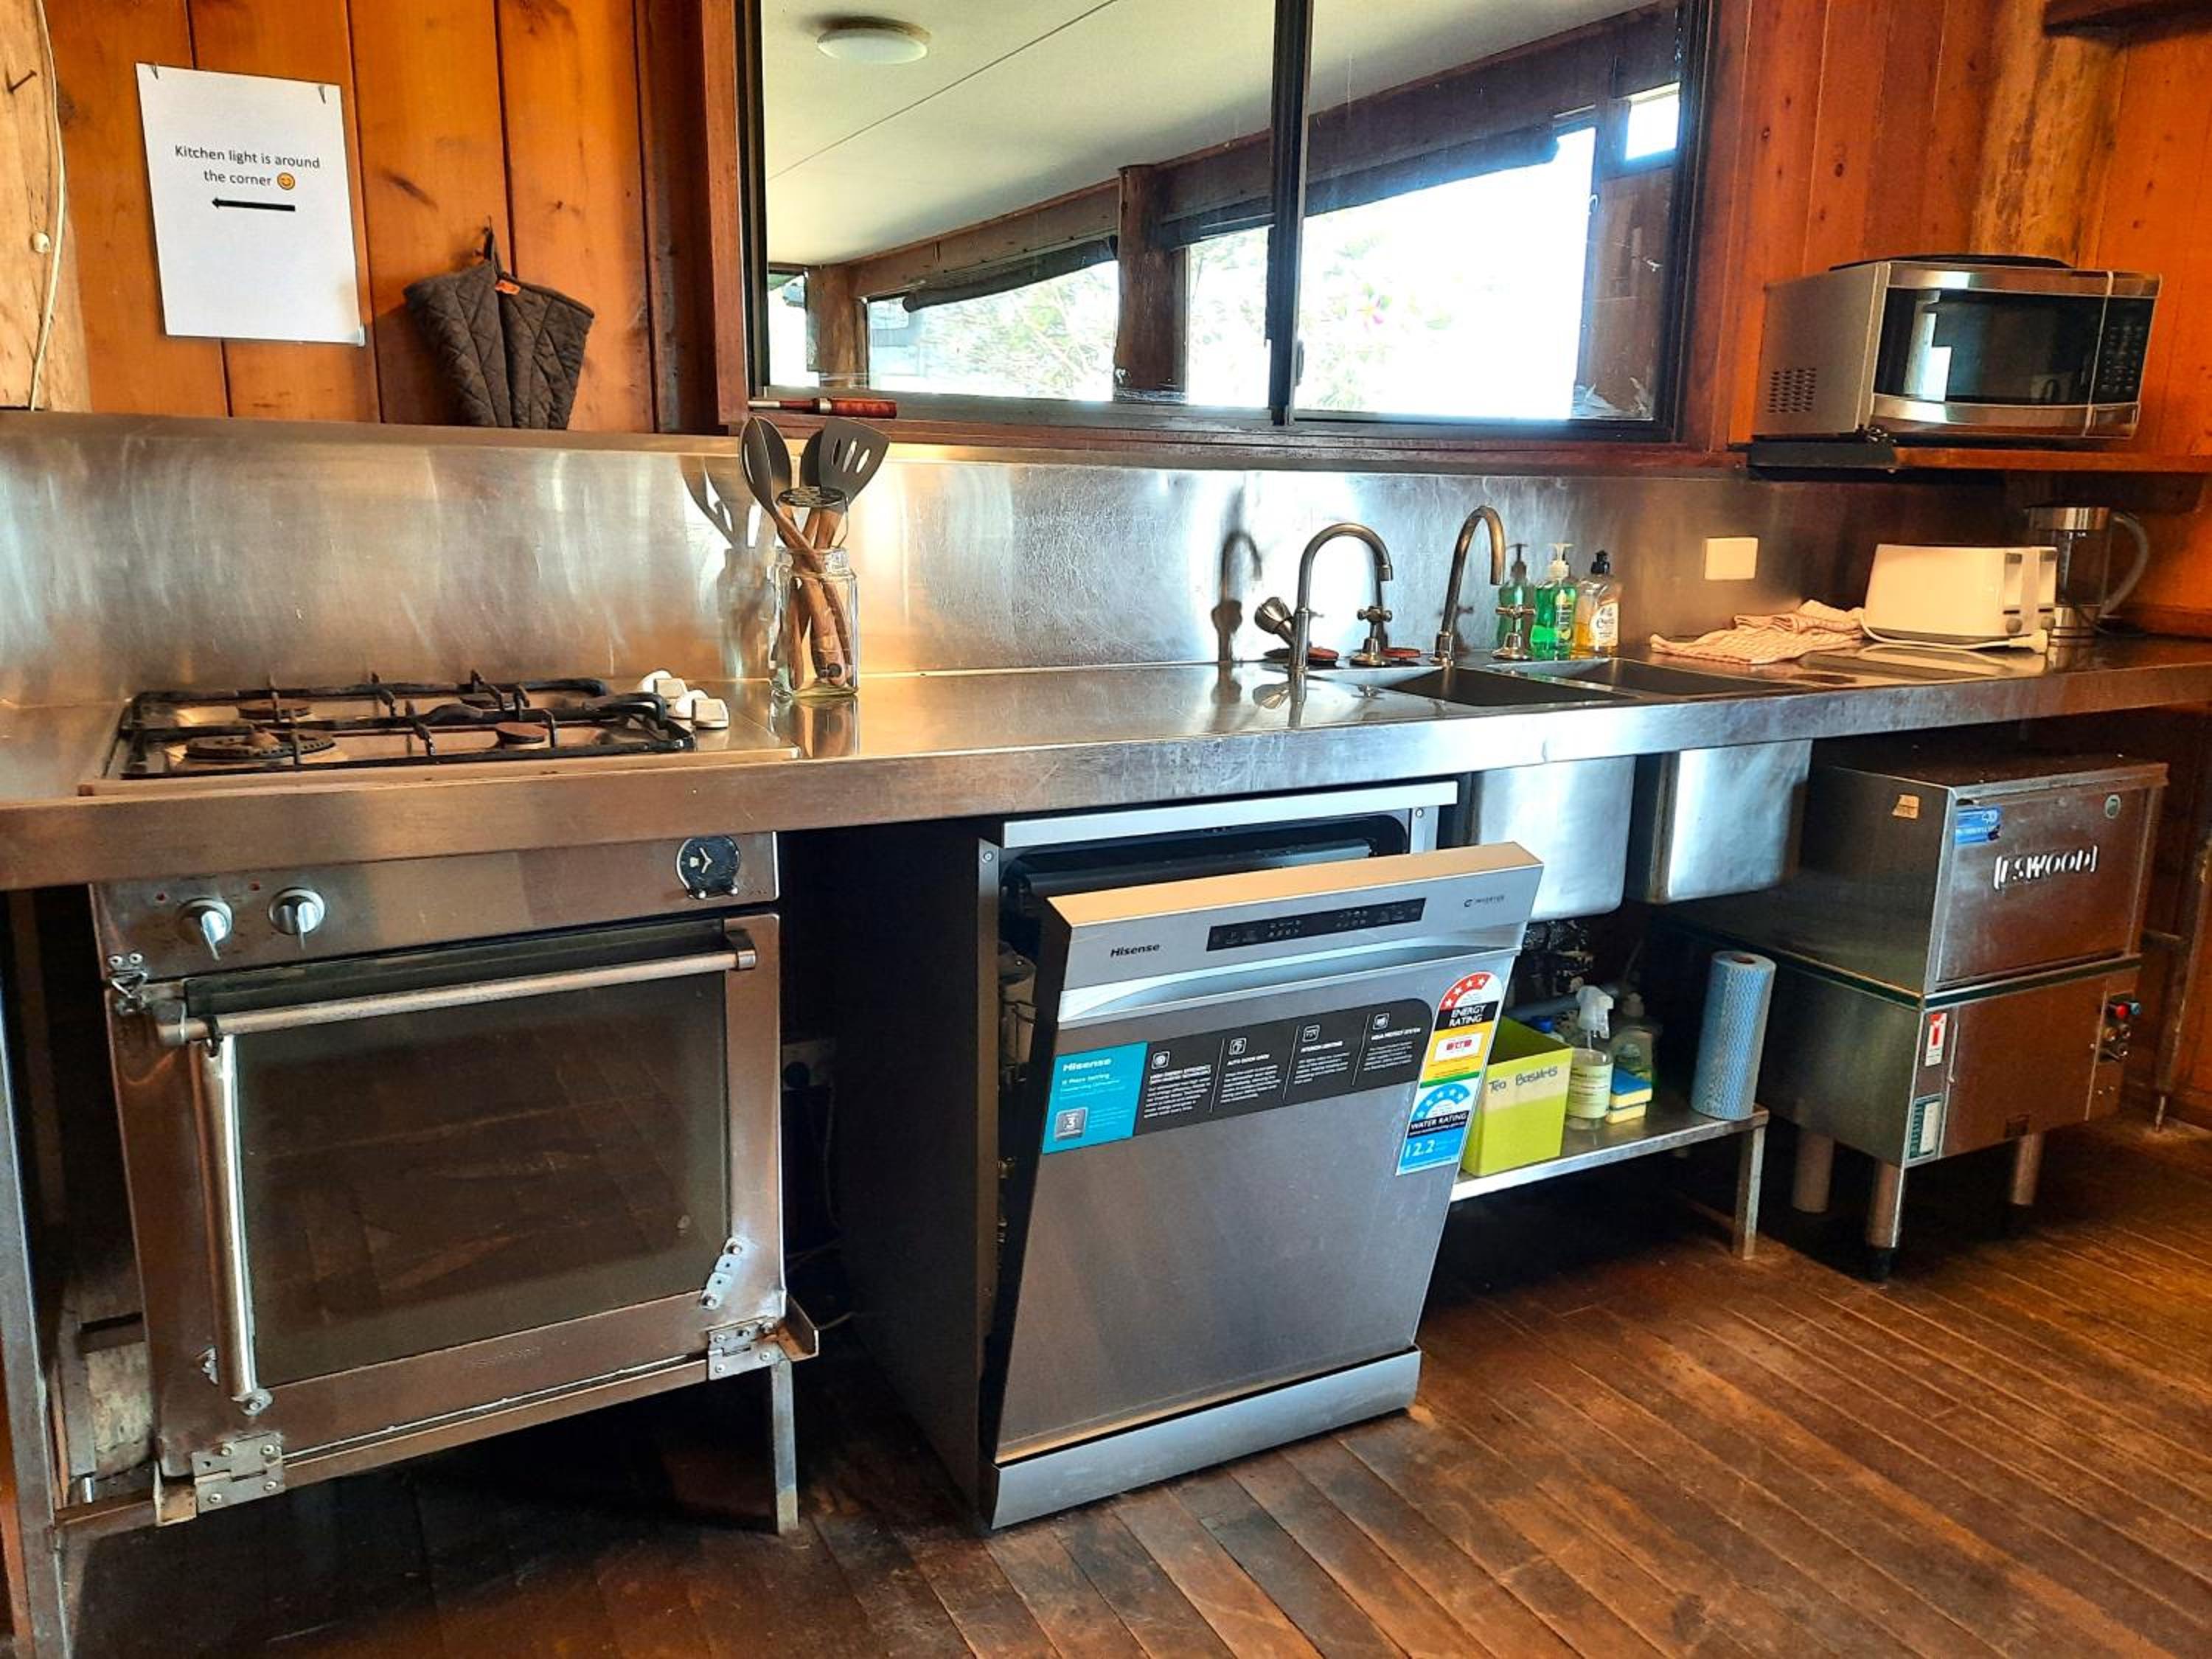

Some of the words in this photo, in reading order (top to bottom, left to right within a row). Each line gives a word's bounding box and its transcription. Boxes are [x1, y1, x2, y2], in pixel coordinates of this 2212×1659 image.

[175, 145, 224, 161] Kitchen
[229, 150, 257, 164] light
[261, 153, 271, 164] is
[274, 155, 320, 168] around
[204, 170, 226, 182] the
[229, 174, 271, 186] corner
[1110, 944, 1161, 958] Hisense
[1451, 1004, 1487, 1018] ENERGY
[1448, 1015, 1484, 1027] RATING
[1062, 1057, 1112, 1071] Hisense
[1410, 1119, 1437, 1130] WATER
[1439, 1113, 1467, 1124] RATING
[1405, 1139, 1436, 1158] 12.2
